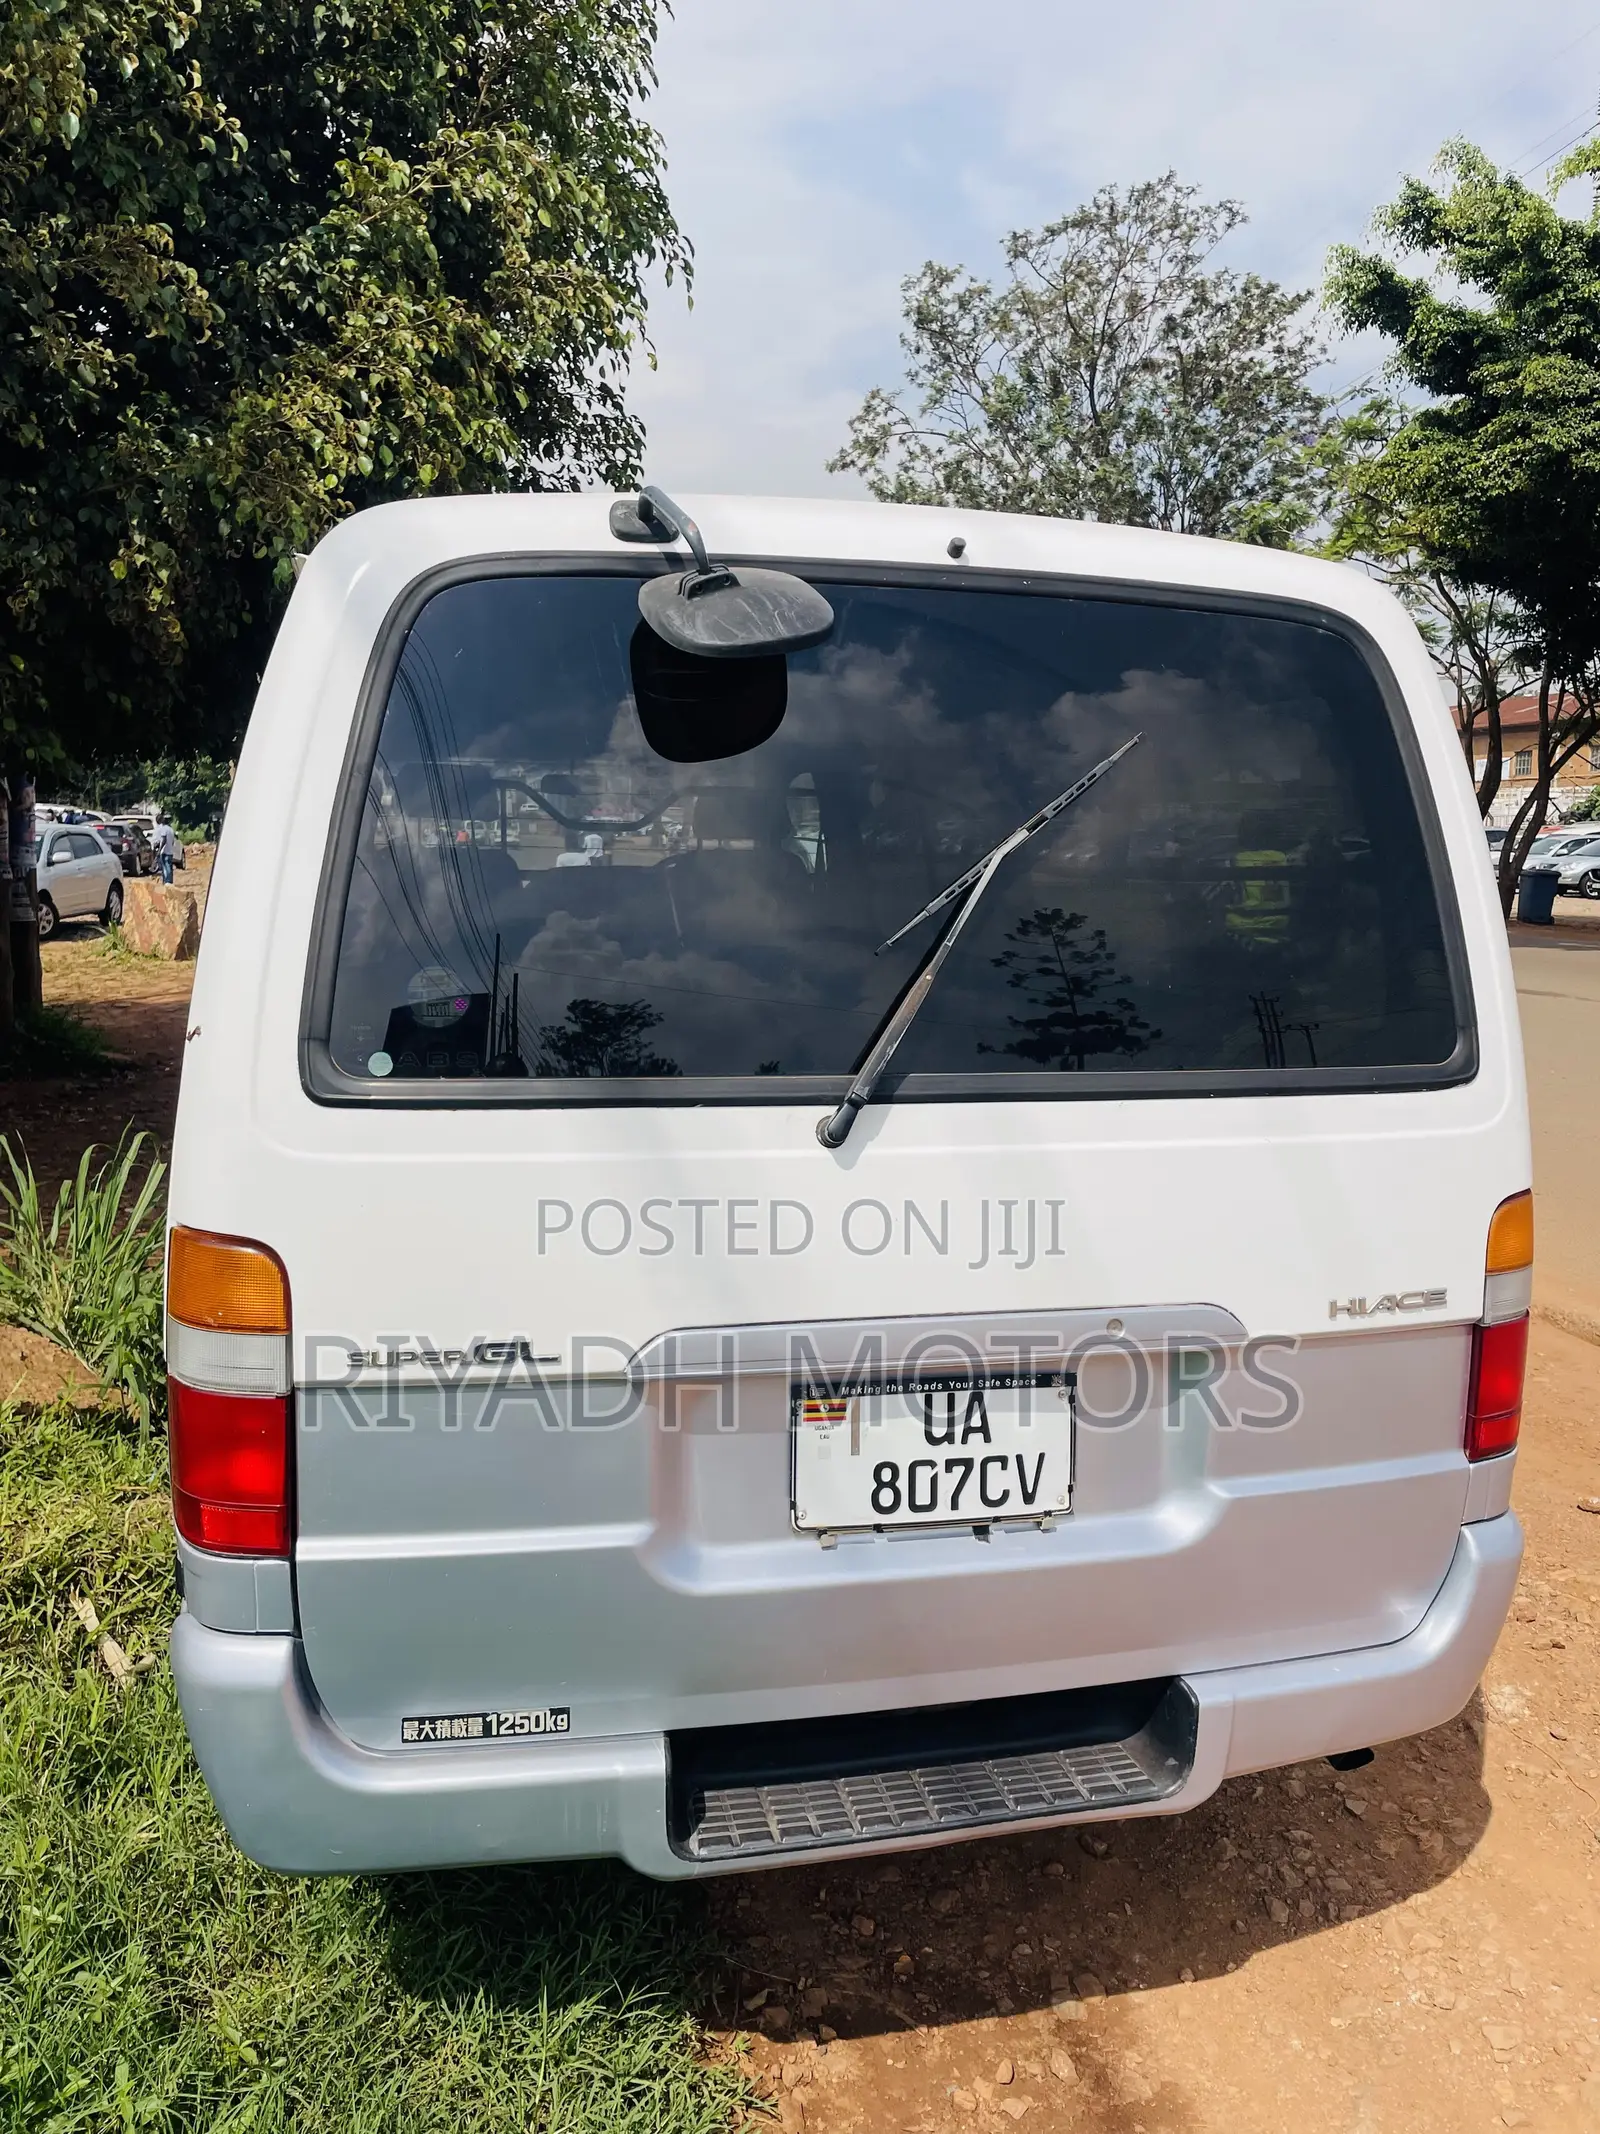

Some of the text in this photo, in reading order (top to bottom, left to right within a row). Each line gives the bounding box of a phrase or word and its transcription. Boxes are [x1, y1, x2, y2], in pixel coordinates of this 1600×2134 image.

[396, 1051, 479, 1069] ABS
[1328, 1287, 1448, 1320] HIACE
[346, 1338, 561, 1368] SUPER GL
[841, 1377, 1037, 1396] Making the Roads Your Safe Space
[924, 1390, 992, 1447] UA
[871, 1452, 1046, 1515] 807CV
[486, 1710, 569, 1737] 1250kg
